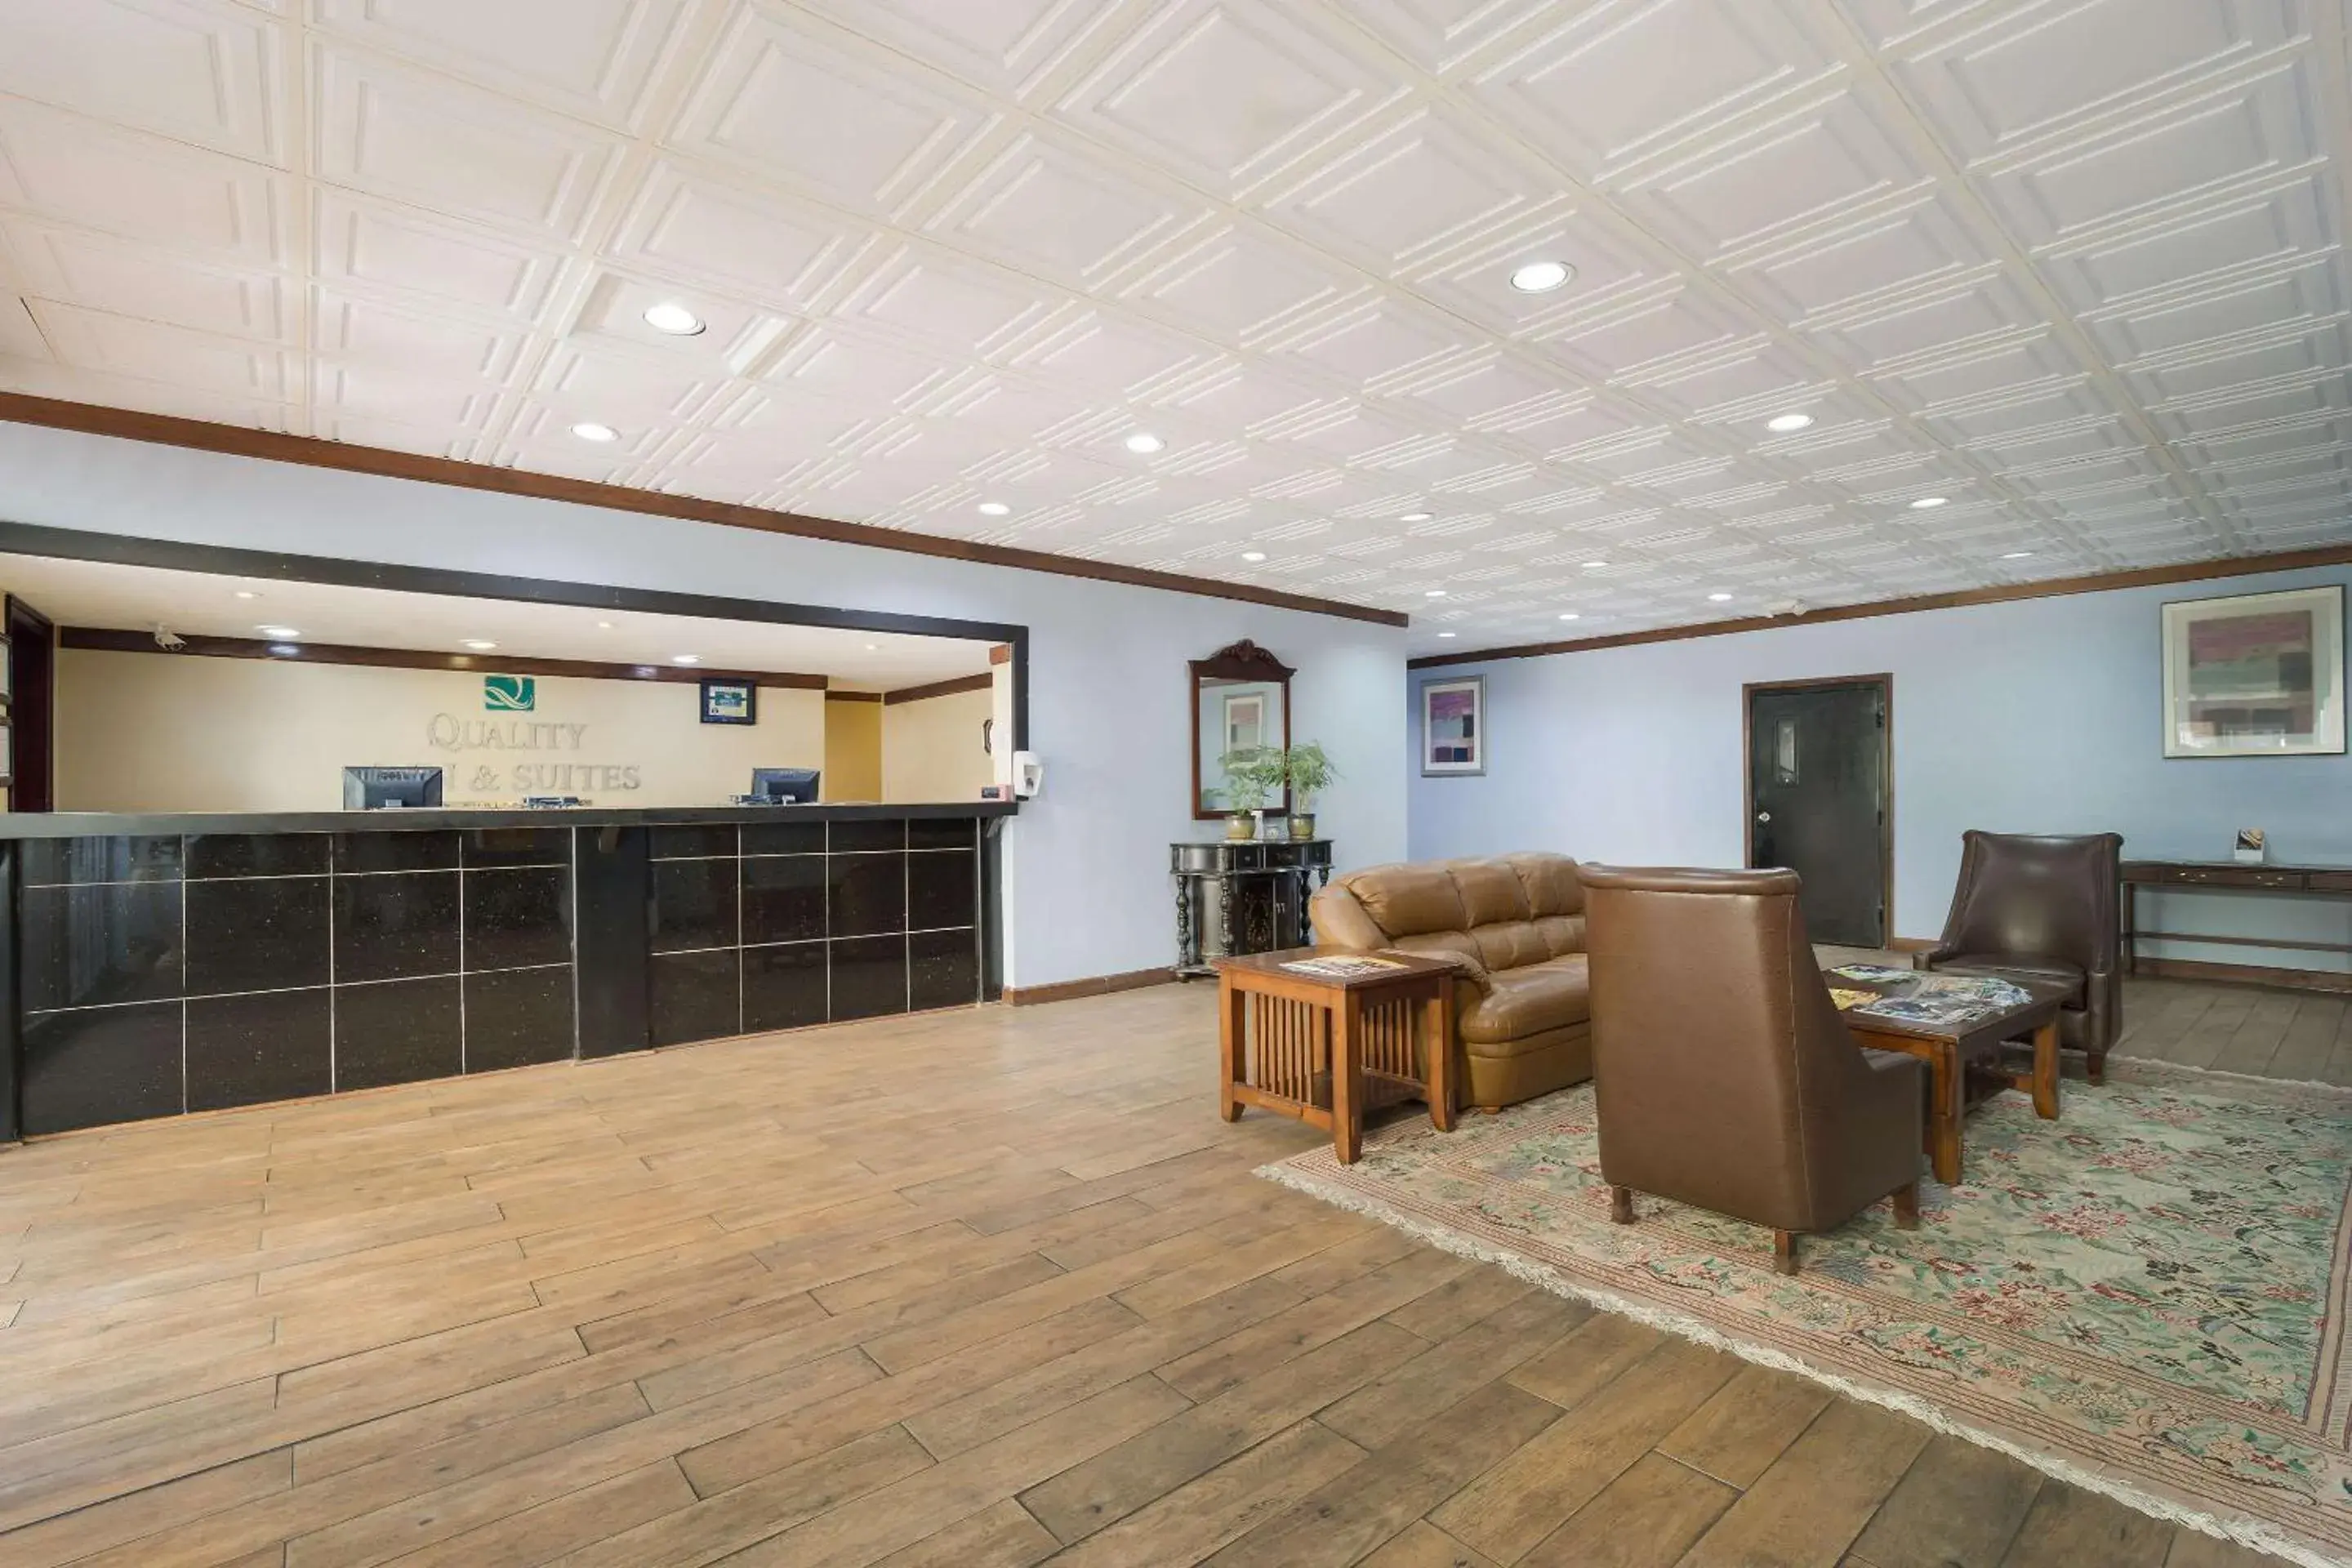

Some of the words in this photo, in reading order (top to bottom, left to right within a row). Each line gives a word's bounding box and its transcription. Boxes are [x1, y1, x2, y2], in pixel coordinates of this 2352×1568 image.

[427, 713, 589, 751] QUALITY
[469, 764, 500, 791] &
[511, 764, 642, 791] SUITES
